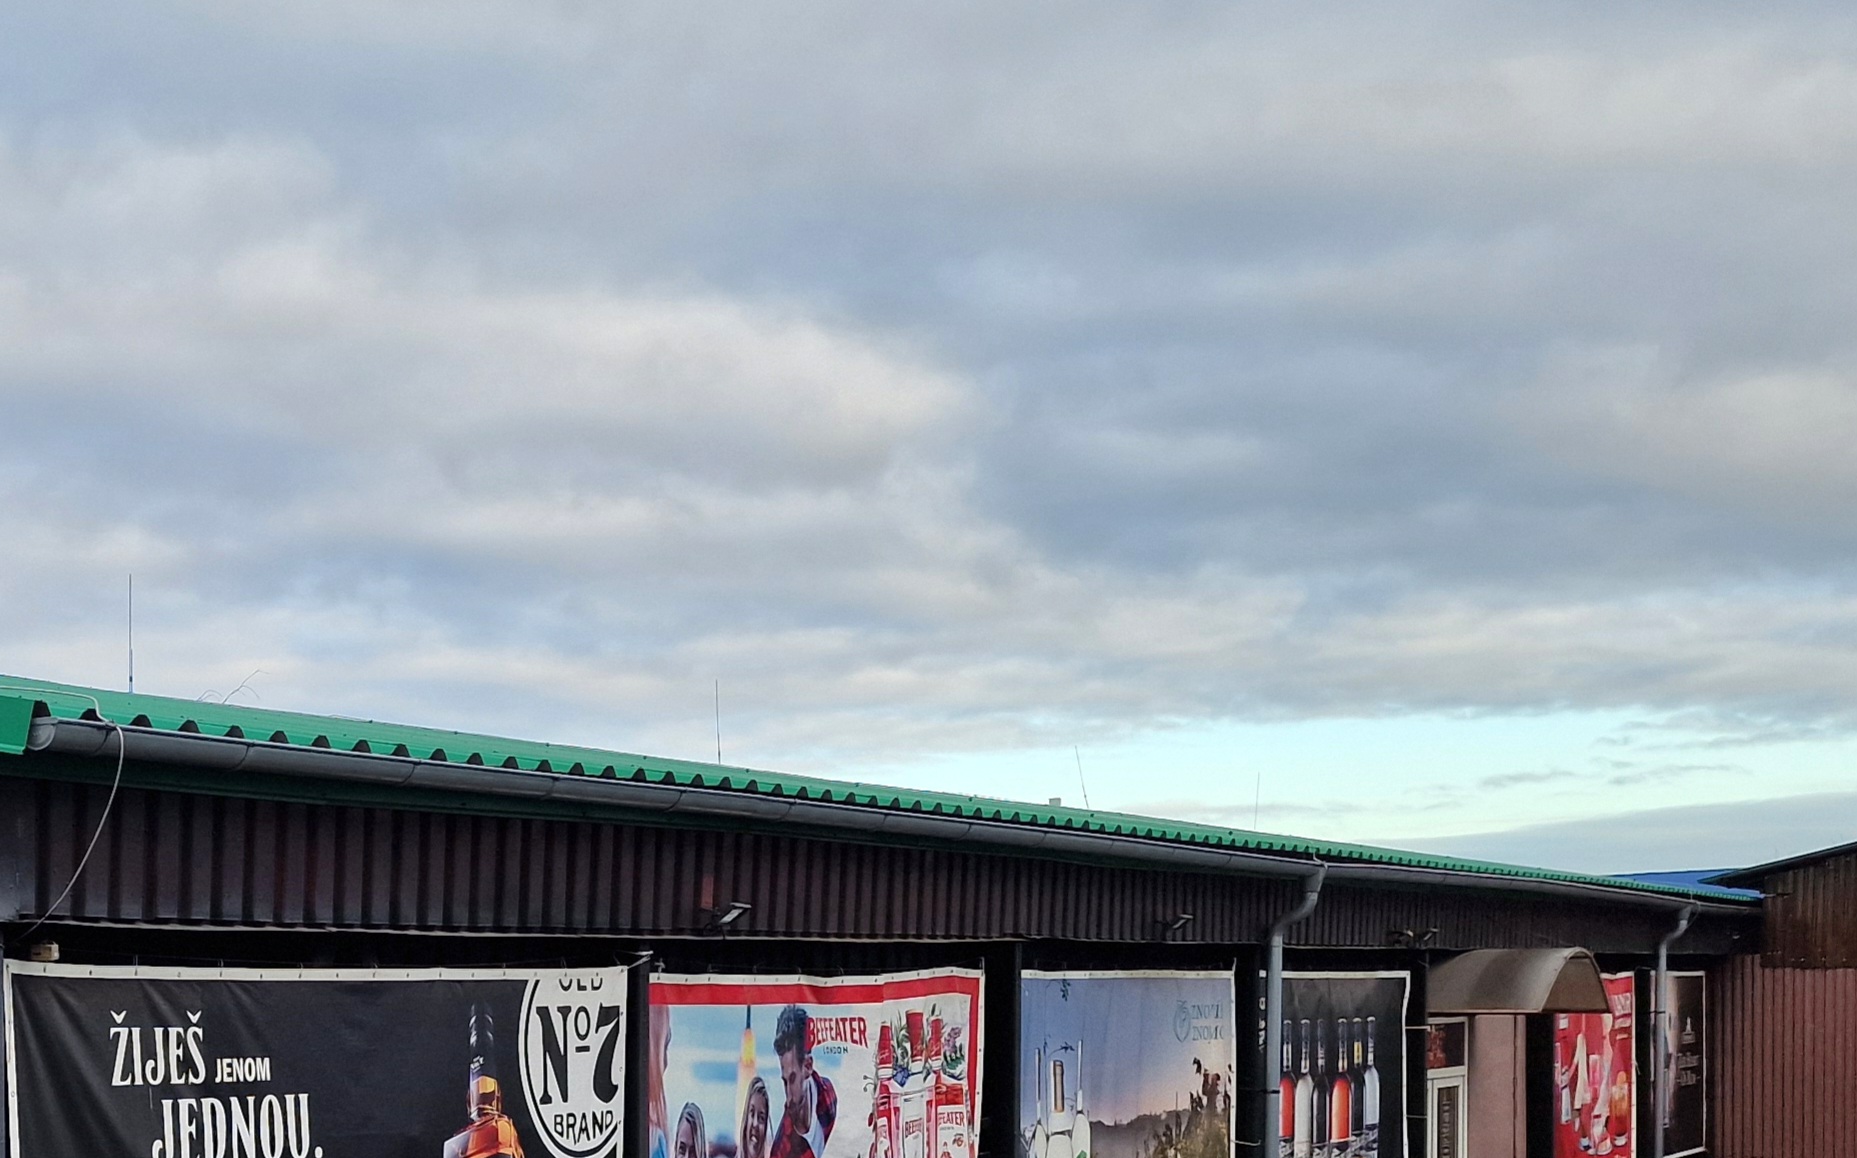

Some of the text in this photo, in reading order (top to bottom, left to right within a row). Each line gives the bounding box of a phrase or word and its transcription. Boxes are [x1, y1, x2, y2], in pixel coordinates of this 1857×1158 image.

[110, 1010, 271, 1086] ŽIJEŠ JENOM
[806, 1016, 869, 1052] BEEFEATER
[554, 1110, 614, 1146] BRAND
